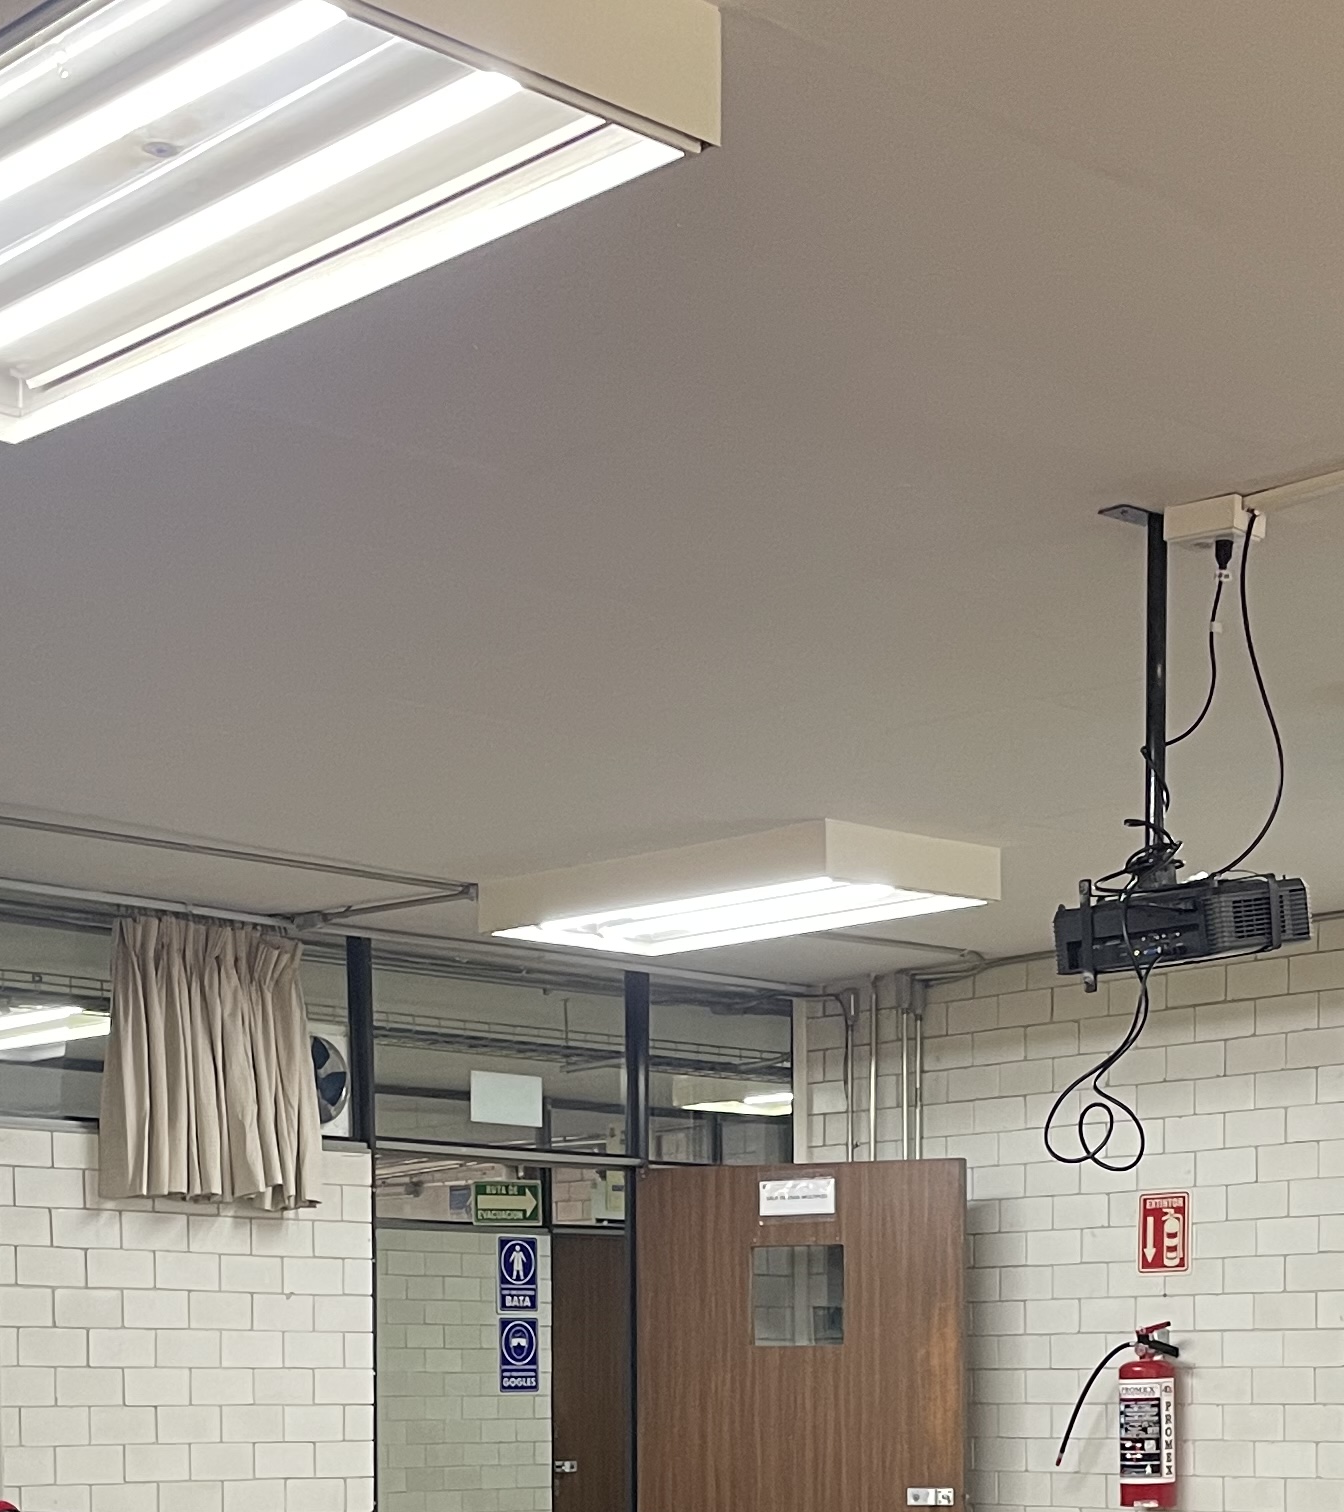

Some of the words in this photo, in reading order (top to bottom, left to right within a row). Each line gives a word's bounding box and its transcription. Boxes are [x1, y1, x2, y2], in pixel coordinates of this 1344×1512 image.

[1146, 1198, 1184, 1209] EXTINTOR
[505, 1296, 531, 1307] BATA
[502, 1378, 536, 1387] GOGLES
[1164, 1401, 1173, 1475] PROMEX
